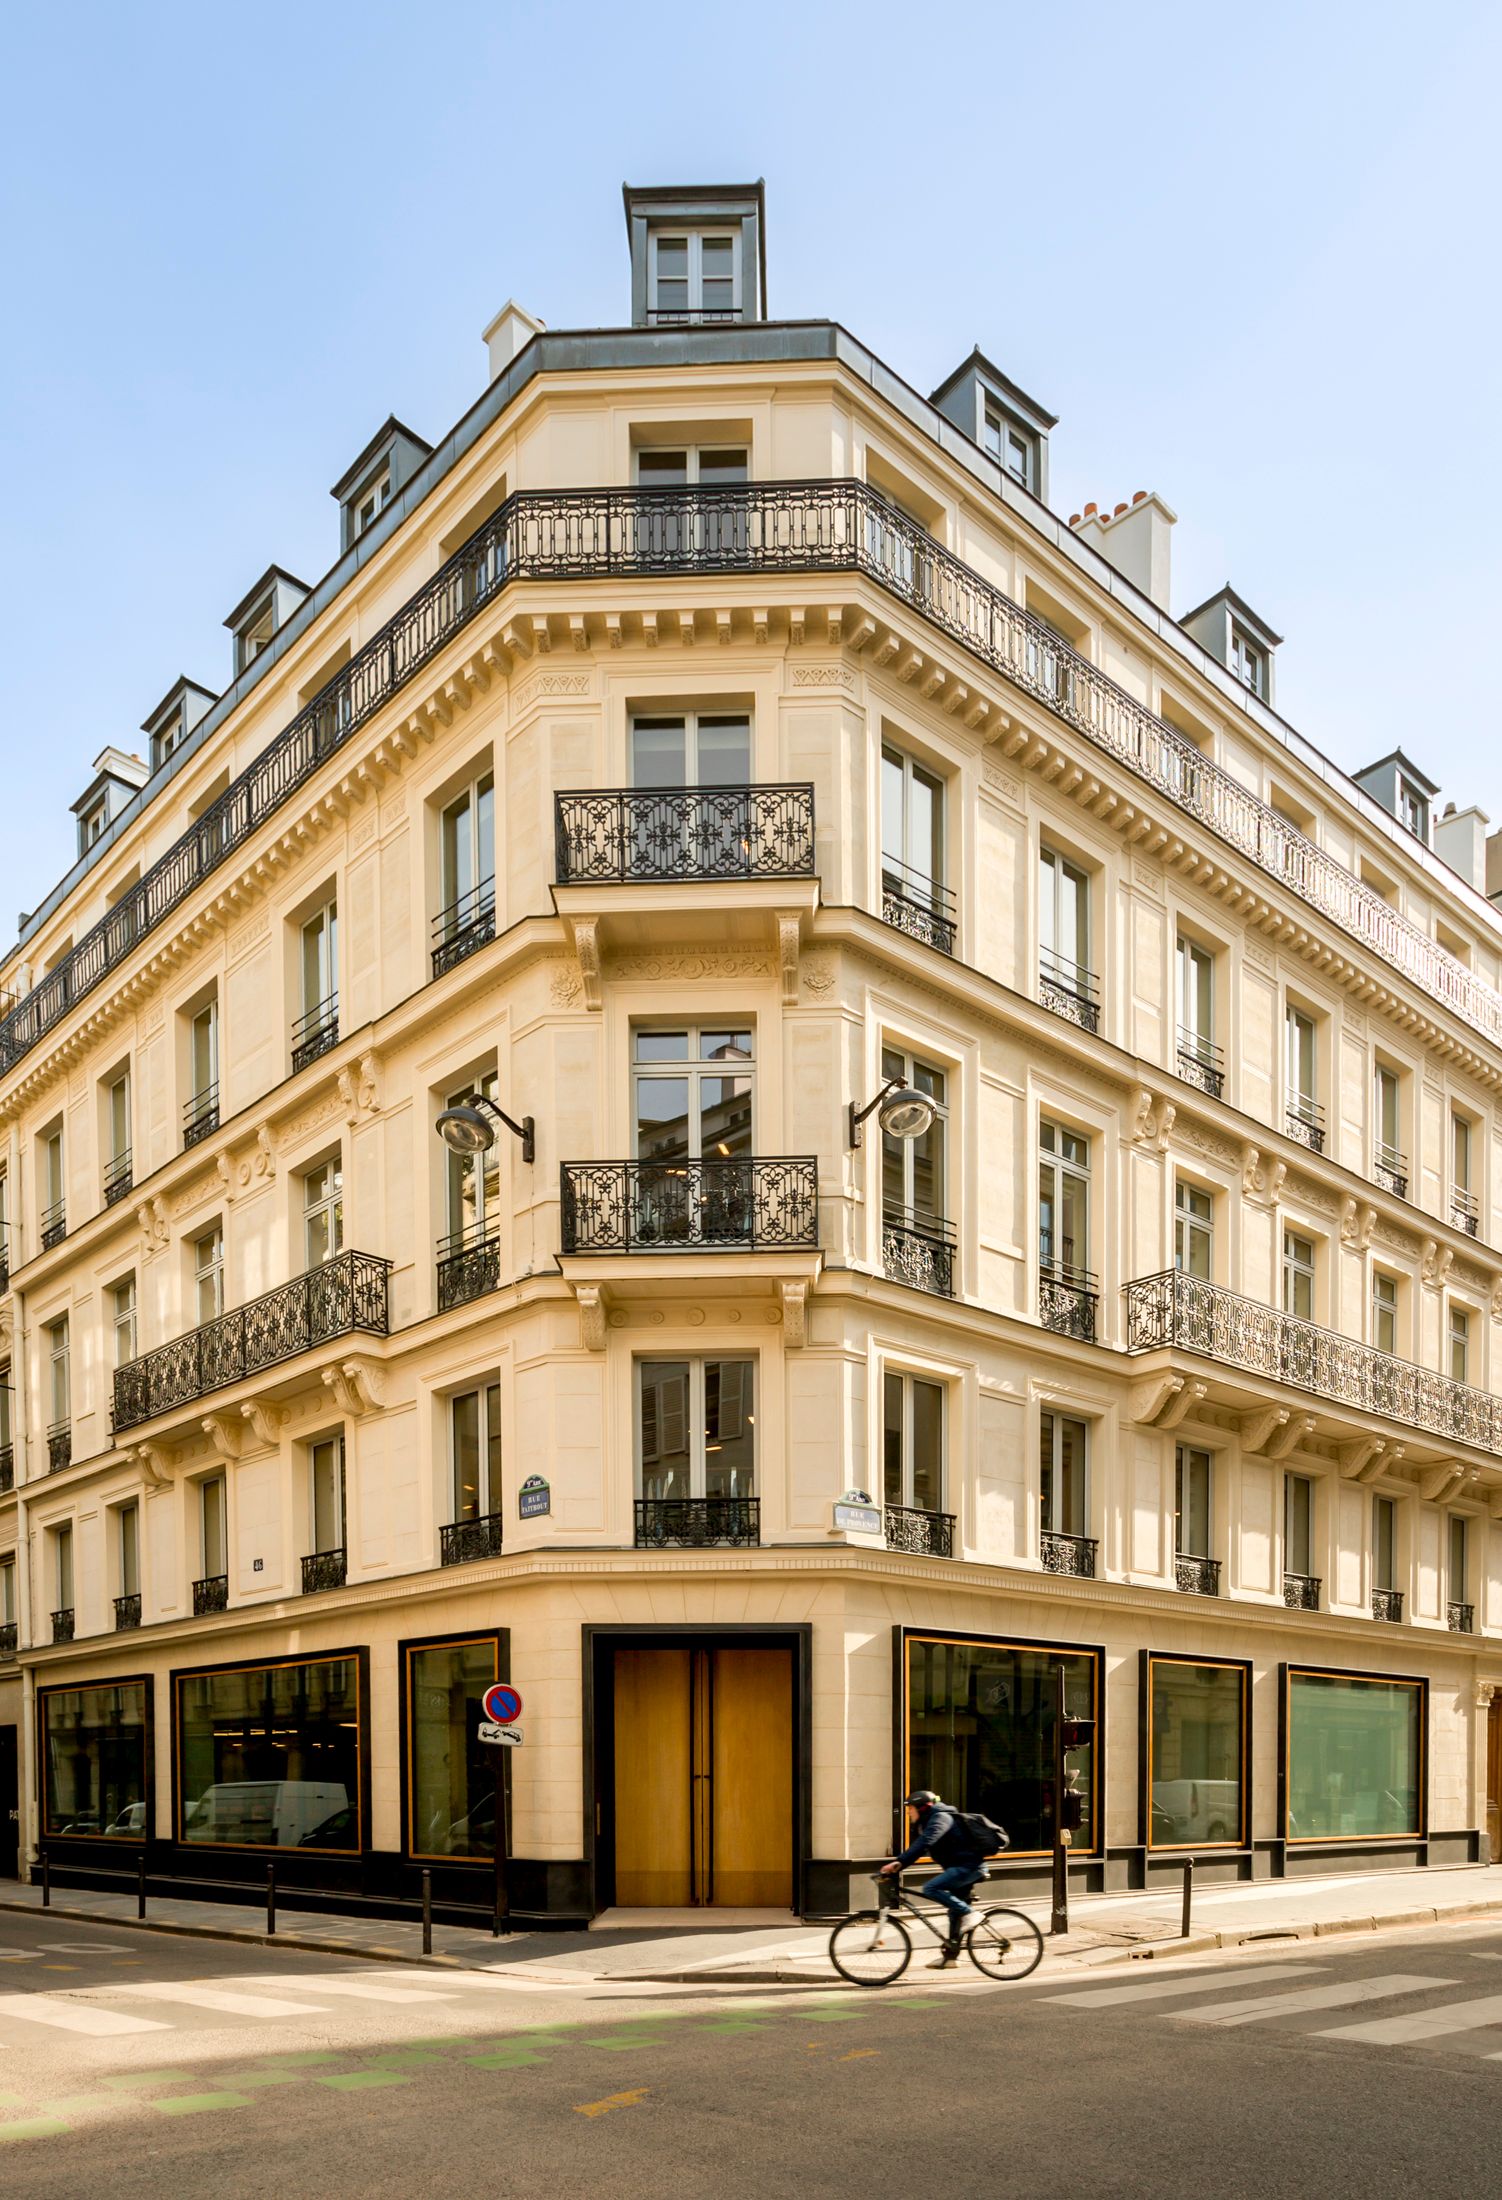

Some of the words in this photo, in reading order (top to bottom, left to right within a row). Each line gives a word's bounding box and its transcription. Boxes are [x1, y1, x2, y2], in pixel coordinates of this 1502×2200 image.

[528, 1495, 541, 1503] RUE
[850, 1511, 864, 1519] RUE
[847, 1519, 878, 1529] PROVENCE
